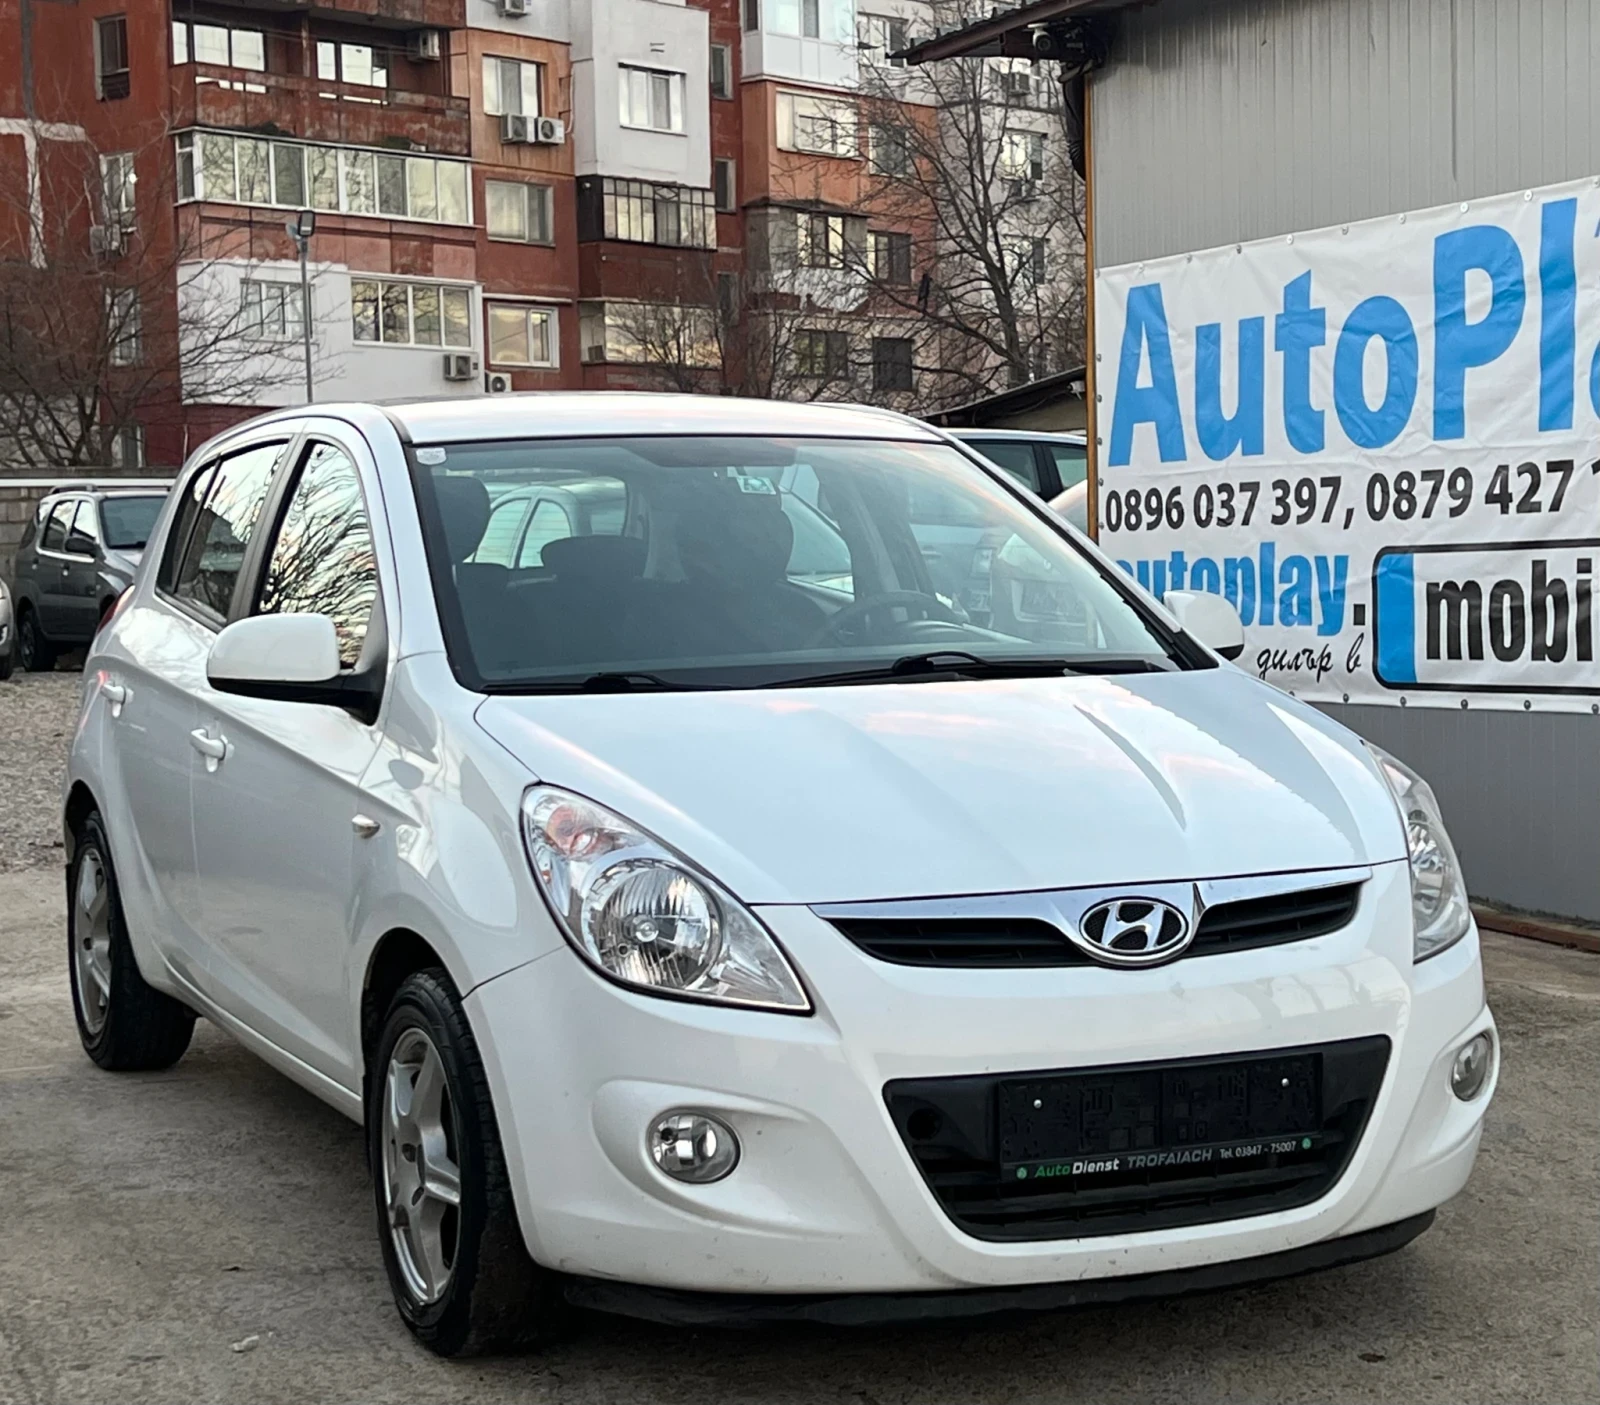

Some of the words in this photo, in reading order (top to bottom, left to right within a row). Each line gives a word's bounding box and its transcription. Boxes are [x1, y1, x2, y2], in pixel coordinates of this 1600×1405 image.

[1108, 198, 1600, 467] AutoPl
[1105, 486, 1185, 533] 0896
[1193, 481, 1261, 529] 037
[1270, 475, 1355, 531] 397,
[1366, 466, 1473, 522] 0879
[1484, 459, 1575, 515] 427
[1127, 1148, 1212, 1168] TROFAIACH
[1235, 1144, 1262, 1157] 03847
[1270, 1140, 1297, 1153] 75007
